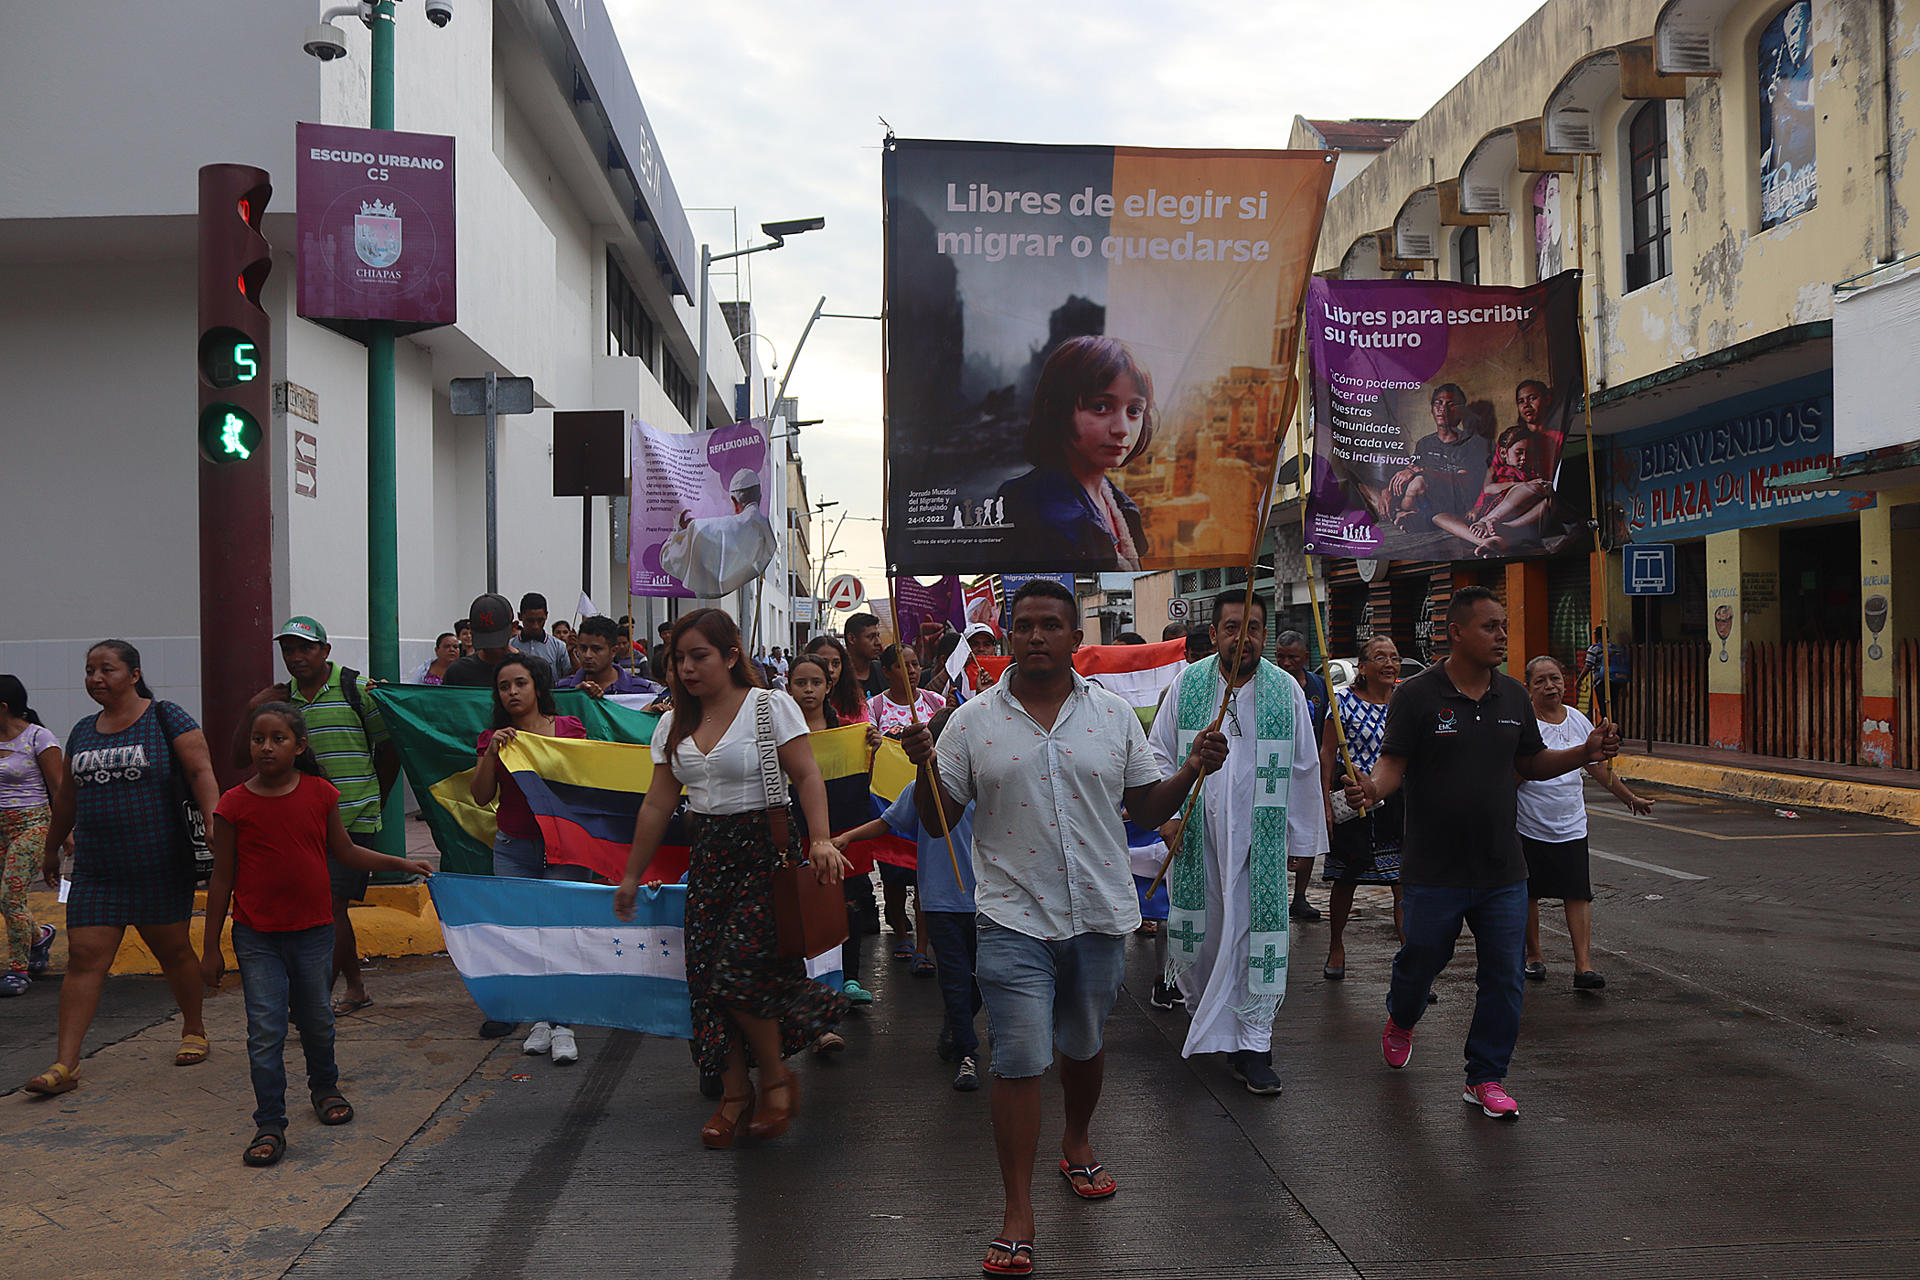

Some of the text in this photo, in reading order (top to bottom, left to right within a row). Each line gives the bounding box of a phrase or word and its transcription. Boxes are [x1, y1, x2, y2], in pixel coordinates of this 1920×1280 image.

[310, 148, 444, 170] ESCUDO URBANO
[640, 124, 663, 209] BBVA
[367, 168, 389, 181] C5
[946, 183, 1268, 225] Libres de elegir si
[937, 228, 1270, 265] migrar o quedarse
[356, 268, 402, 279] CHIAPAS
[1324, 303, 1533, 328] Libres para escribir
[1324, 327, 1421, 348] su futuro
[234, 343, 257, 381] 5
[1331, 383, 1378, 403] hacer que
[1366, 379, 1421, 389] podemos
[1332, 401, 1372, 417] nuestras
[1332, 416, 1401, 435] comunidades
[709, 434, 761, 455] REFLEXIONAR
[1333, 431, 1404, 450] sean cada vez
[1639, 400, 1823, 481] BIENVENIDOS
[1333, 446, 1421, 465] más inclusivas?"
[1628, 493, 1647, 534] La
[1651, 480, 1713, 528] PLAZA
[1714, 472, 1745, 507] Del
[72, 744, 149, 774] ONITA
